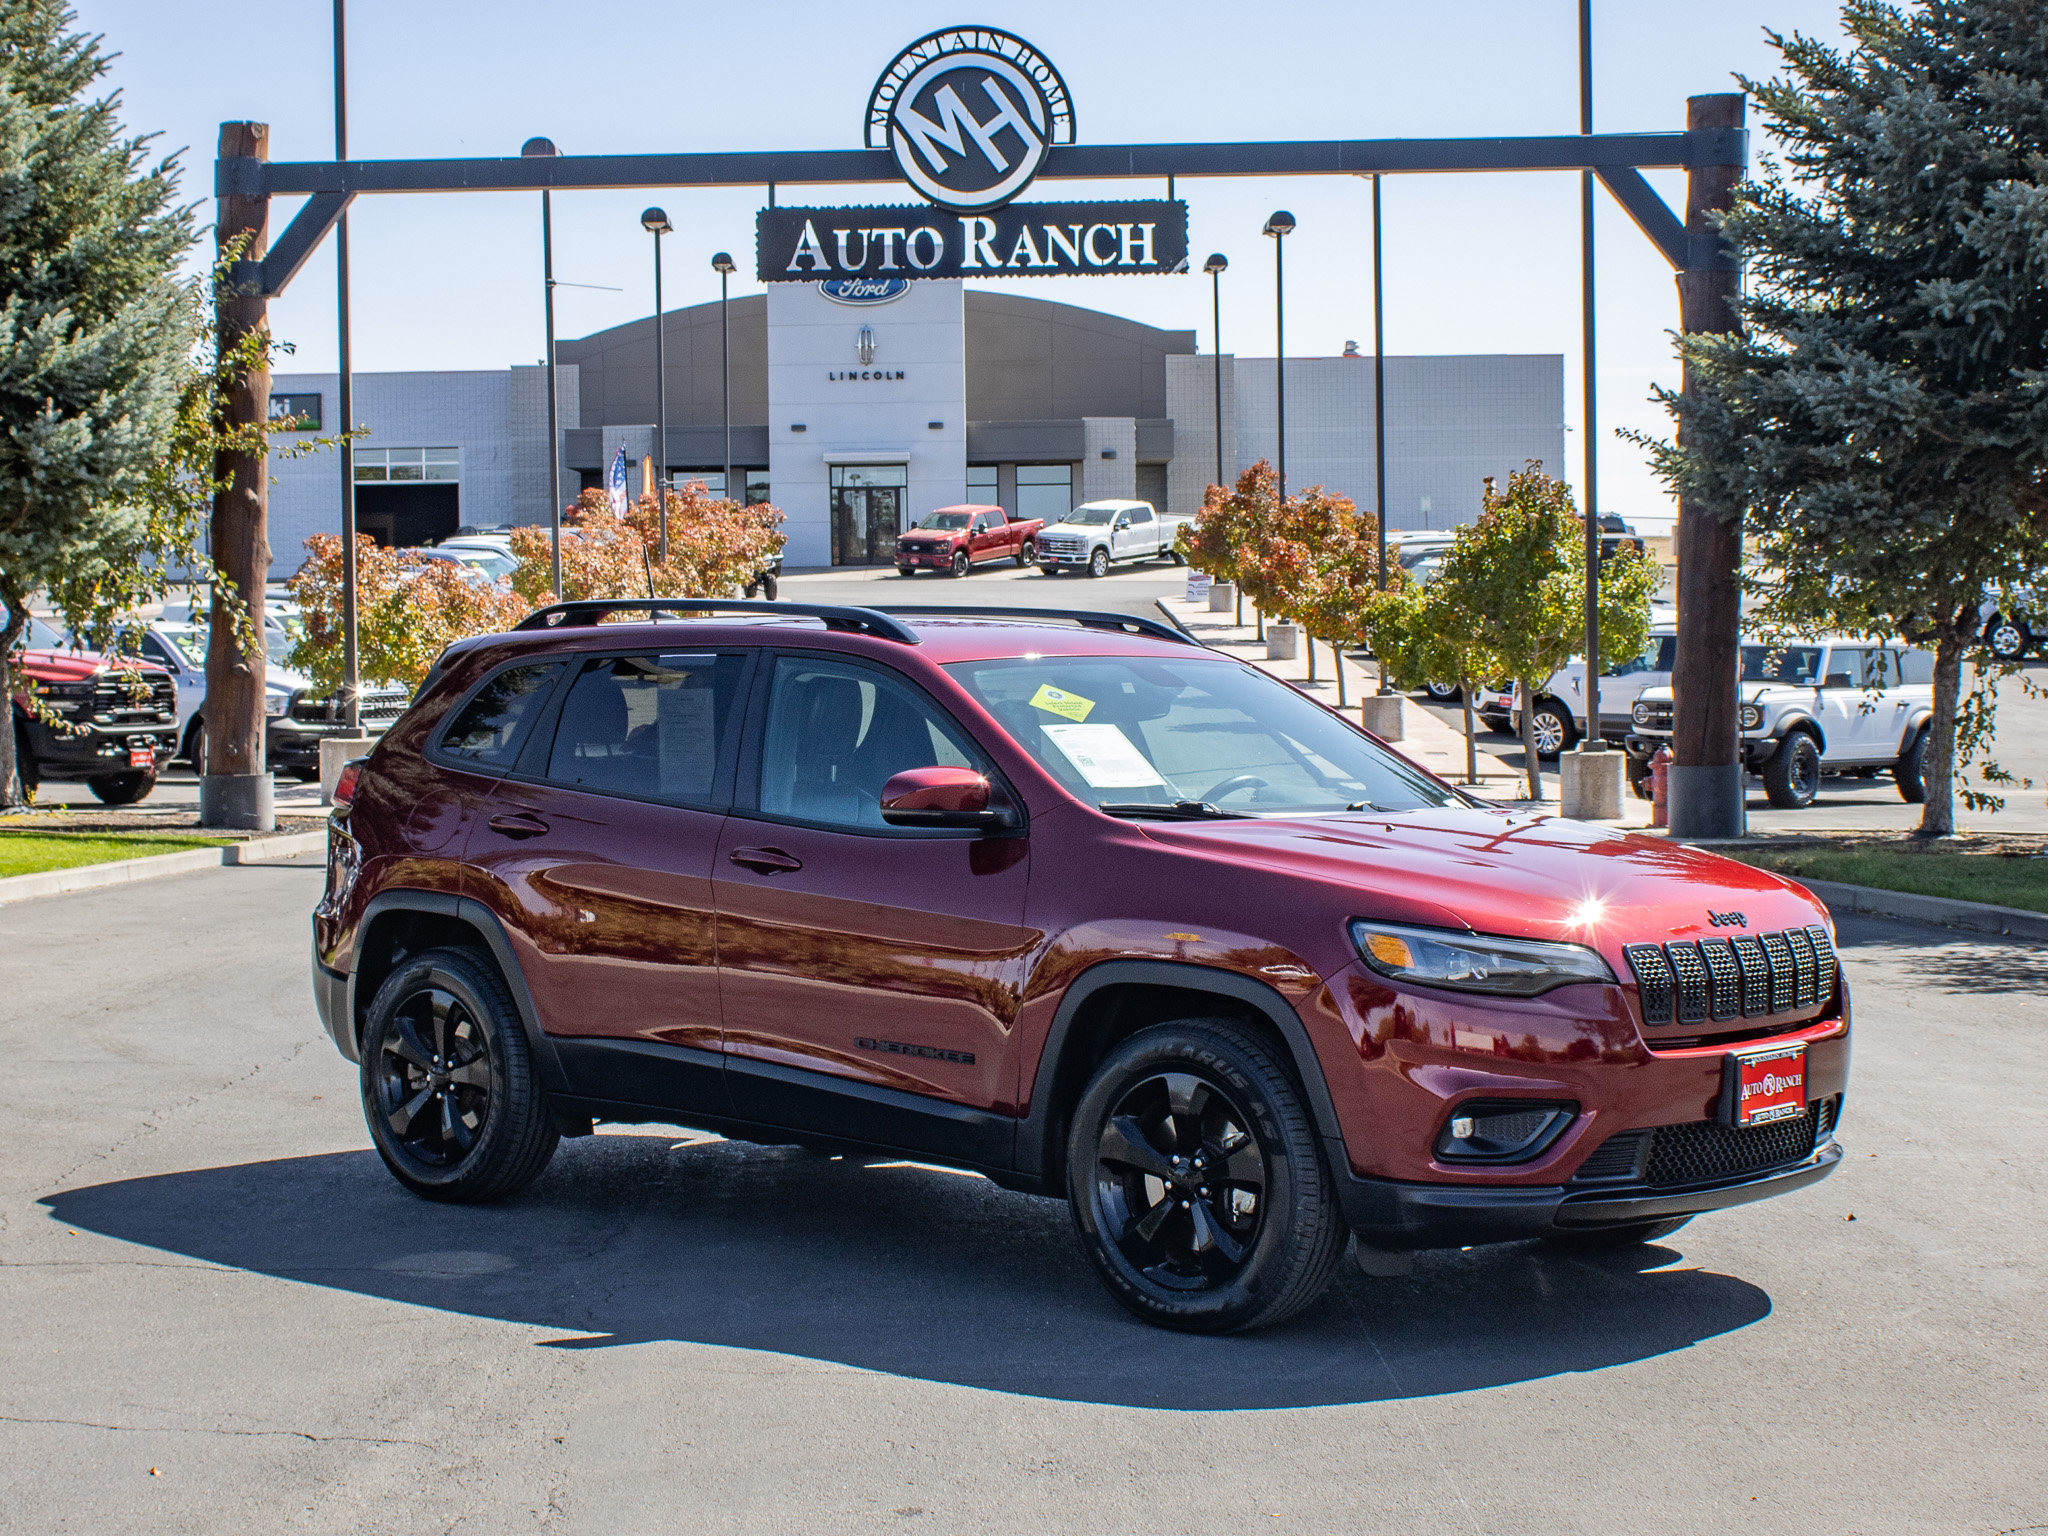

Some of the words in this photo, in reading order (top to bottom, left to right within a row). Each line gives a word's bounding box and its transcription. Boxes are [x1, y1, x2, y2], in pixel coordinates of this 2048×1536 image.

[870, 30, 1004, 127] MOUNTAIN
[1014, 46, 1071, 126] HOME
[894, 76, 1043, 175] MH
[786, 218, 944, 272] AUTO
[957, 215, 1159, 270] RANCH
[838, 278, 890, 297] Ford
[829, 371, 905, 381] LINCOLN
[1706, 909, 1748, 928] Jeep
[853, 1037, 976, 1066] CHEROKEE
[1740, 1082, 1763, 1101] AUTO
[1775, 1073, 1803, 1094] RANCH
